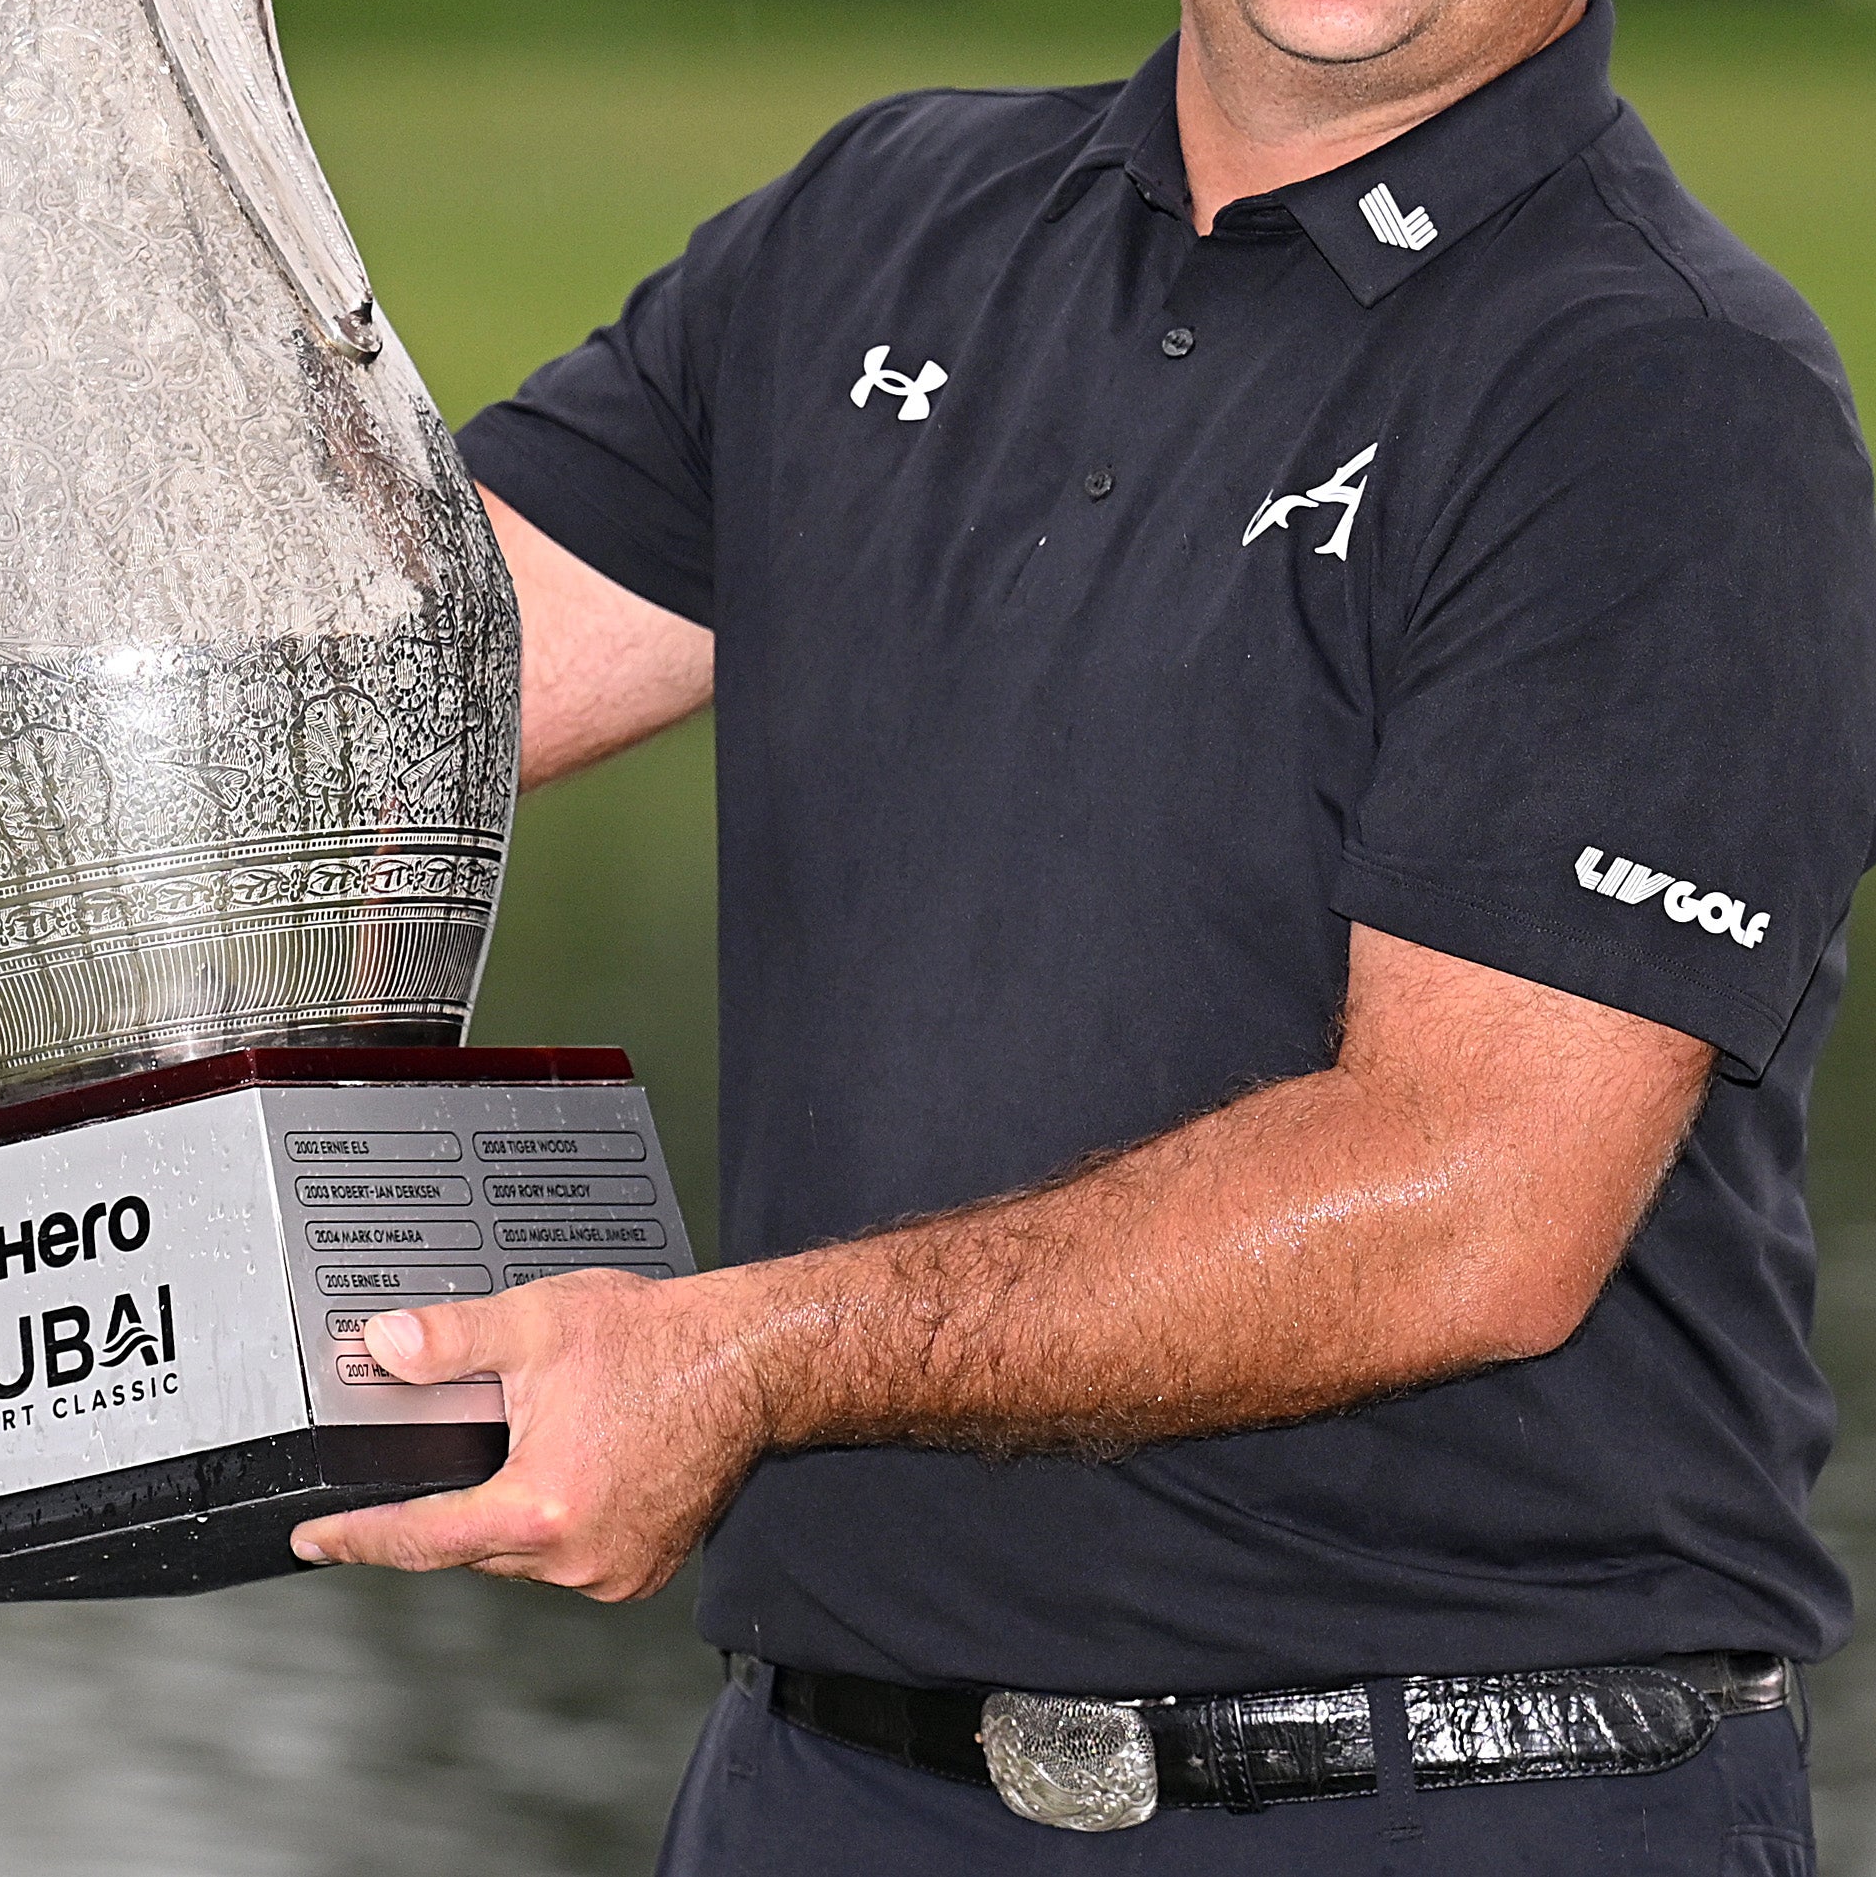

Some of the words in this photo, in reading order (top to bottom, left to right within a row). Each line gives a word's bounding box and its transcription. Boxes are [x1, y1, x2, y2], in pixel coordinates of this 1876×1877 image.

[294, 1141, 320, 1155] 2002
[321, 1141, 350, 1155] ERNIE
[351, 1140, 370, 1154] ELS
[507, 1140, 538, 1154] TIGER
[538, 1139, 578, 1153] WOODS
[304, 1185, 330, 1199] 2003
[330, 1185, 394, 1199] ROBERT-JAN
[395, 1184, 441, 1198] DERKSEN
[492, 1184, 516, 1199] 2009
[518, 1184, 544, 1198] RORY
[546, 1184, 591, 1198] MCILROY
[314, 1229, 341, 1243] 2004
[341, 1229, 373, 1243] MARK
[502, 1228, 528, 1242] 2010
[528, 1228, 568, 1242] MIGUEL
[324, 1274, 351, 1288] 2005
[351, 1274, 380, 1288] ERNIE
[382, 1274, 401, 1287] ELS
[335, 1319, 361, 1333] 2006
[345, 1364, 369, 1378] 2007
[51, 1372, 180, 1420] CLASSIC
